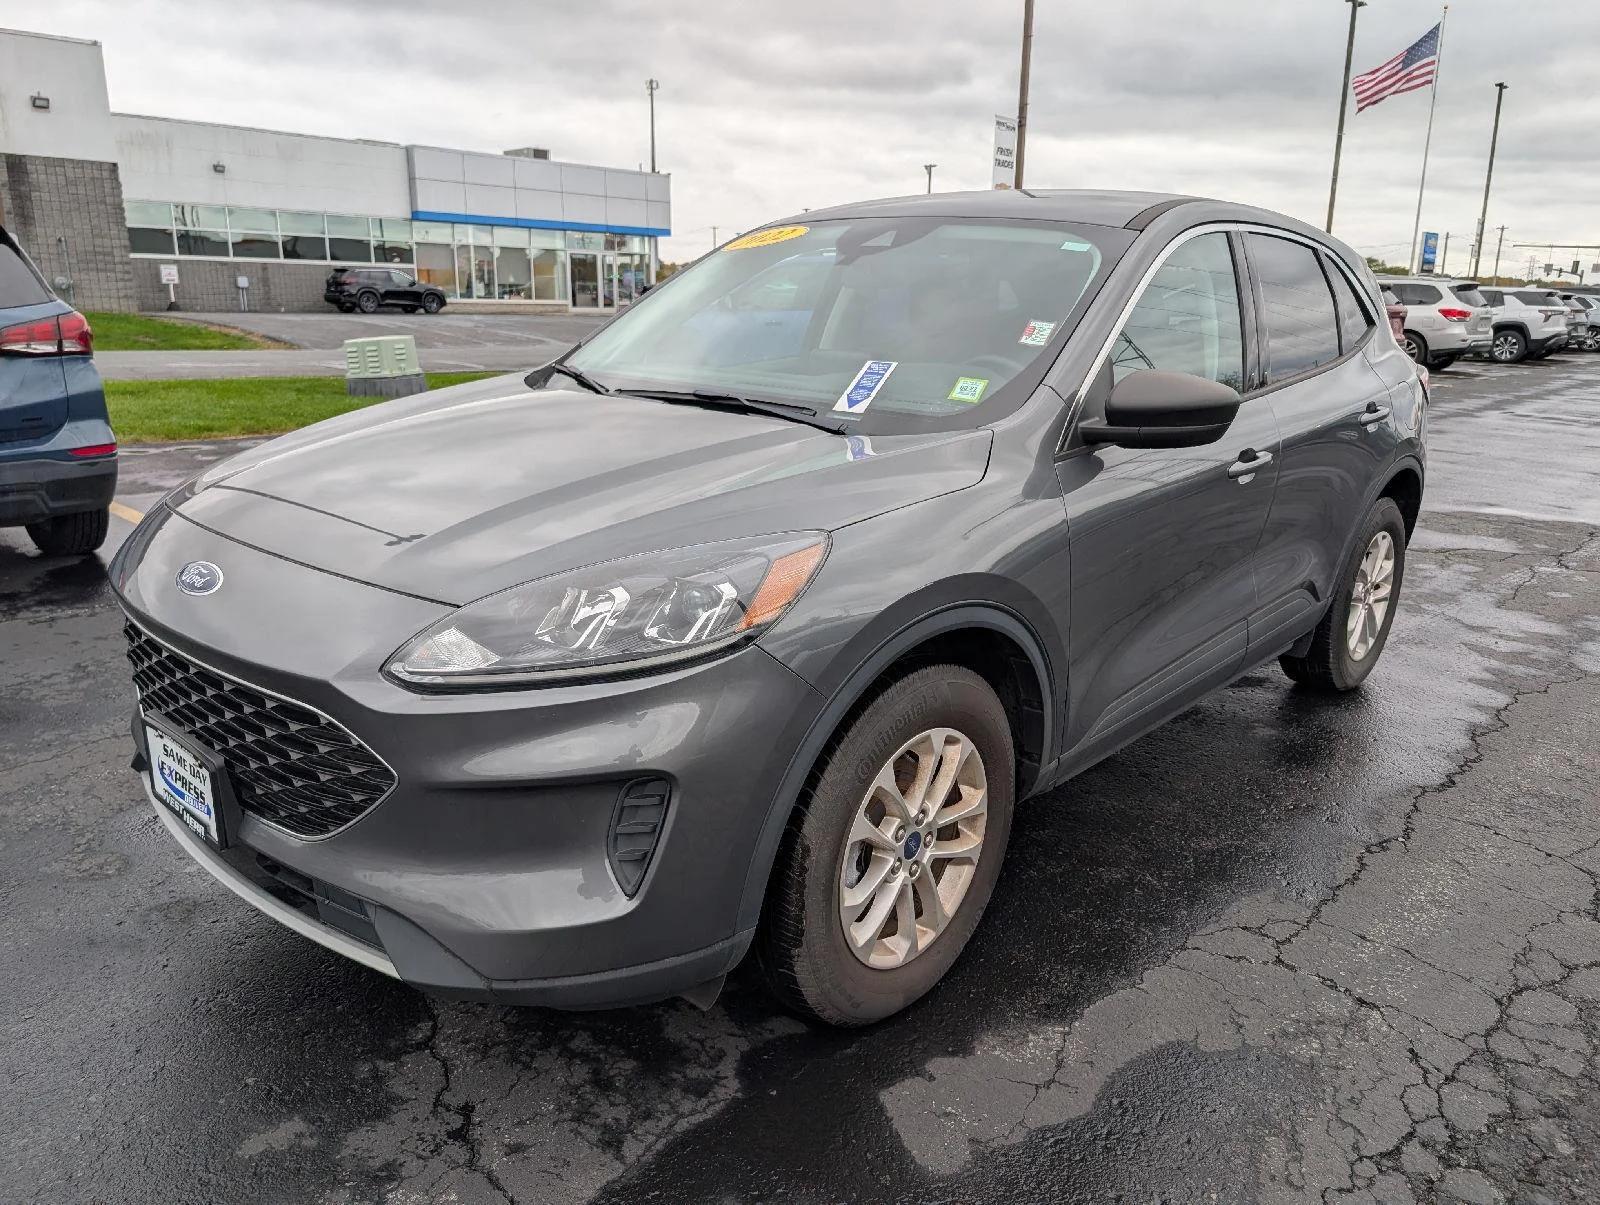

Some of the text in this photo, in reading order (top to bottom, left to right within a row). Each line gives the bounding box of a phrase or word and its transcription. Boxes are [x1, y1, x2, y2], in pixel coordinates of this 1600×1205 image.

[181, 565, 212, 588] Ford
[161, 760, 205, 804] EXPRESS
[163, 744, 207, 786] SAME DAY
[162, 788, 184, 815] WEST
